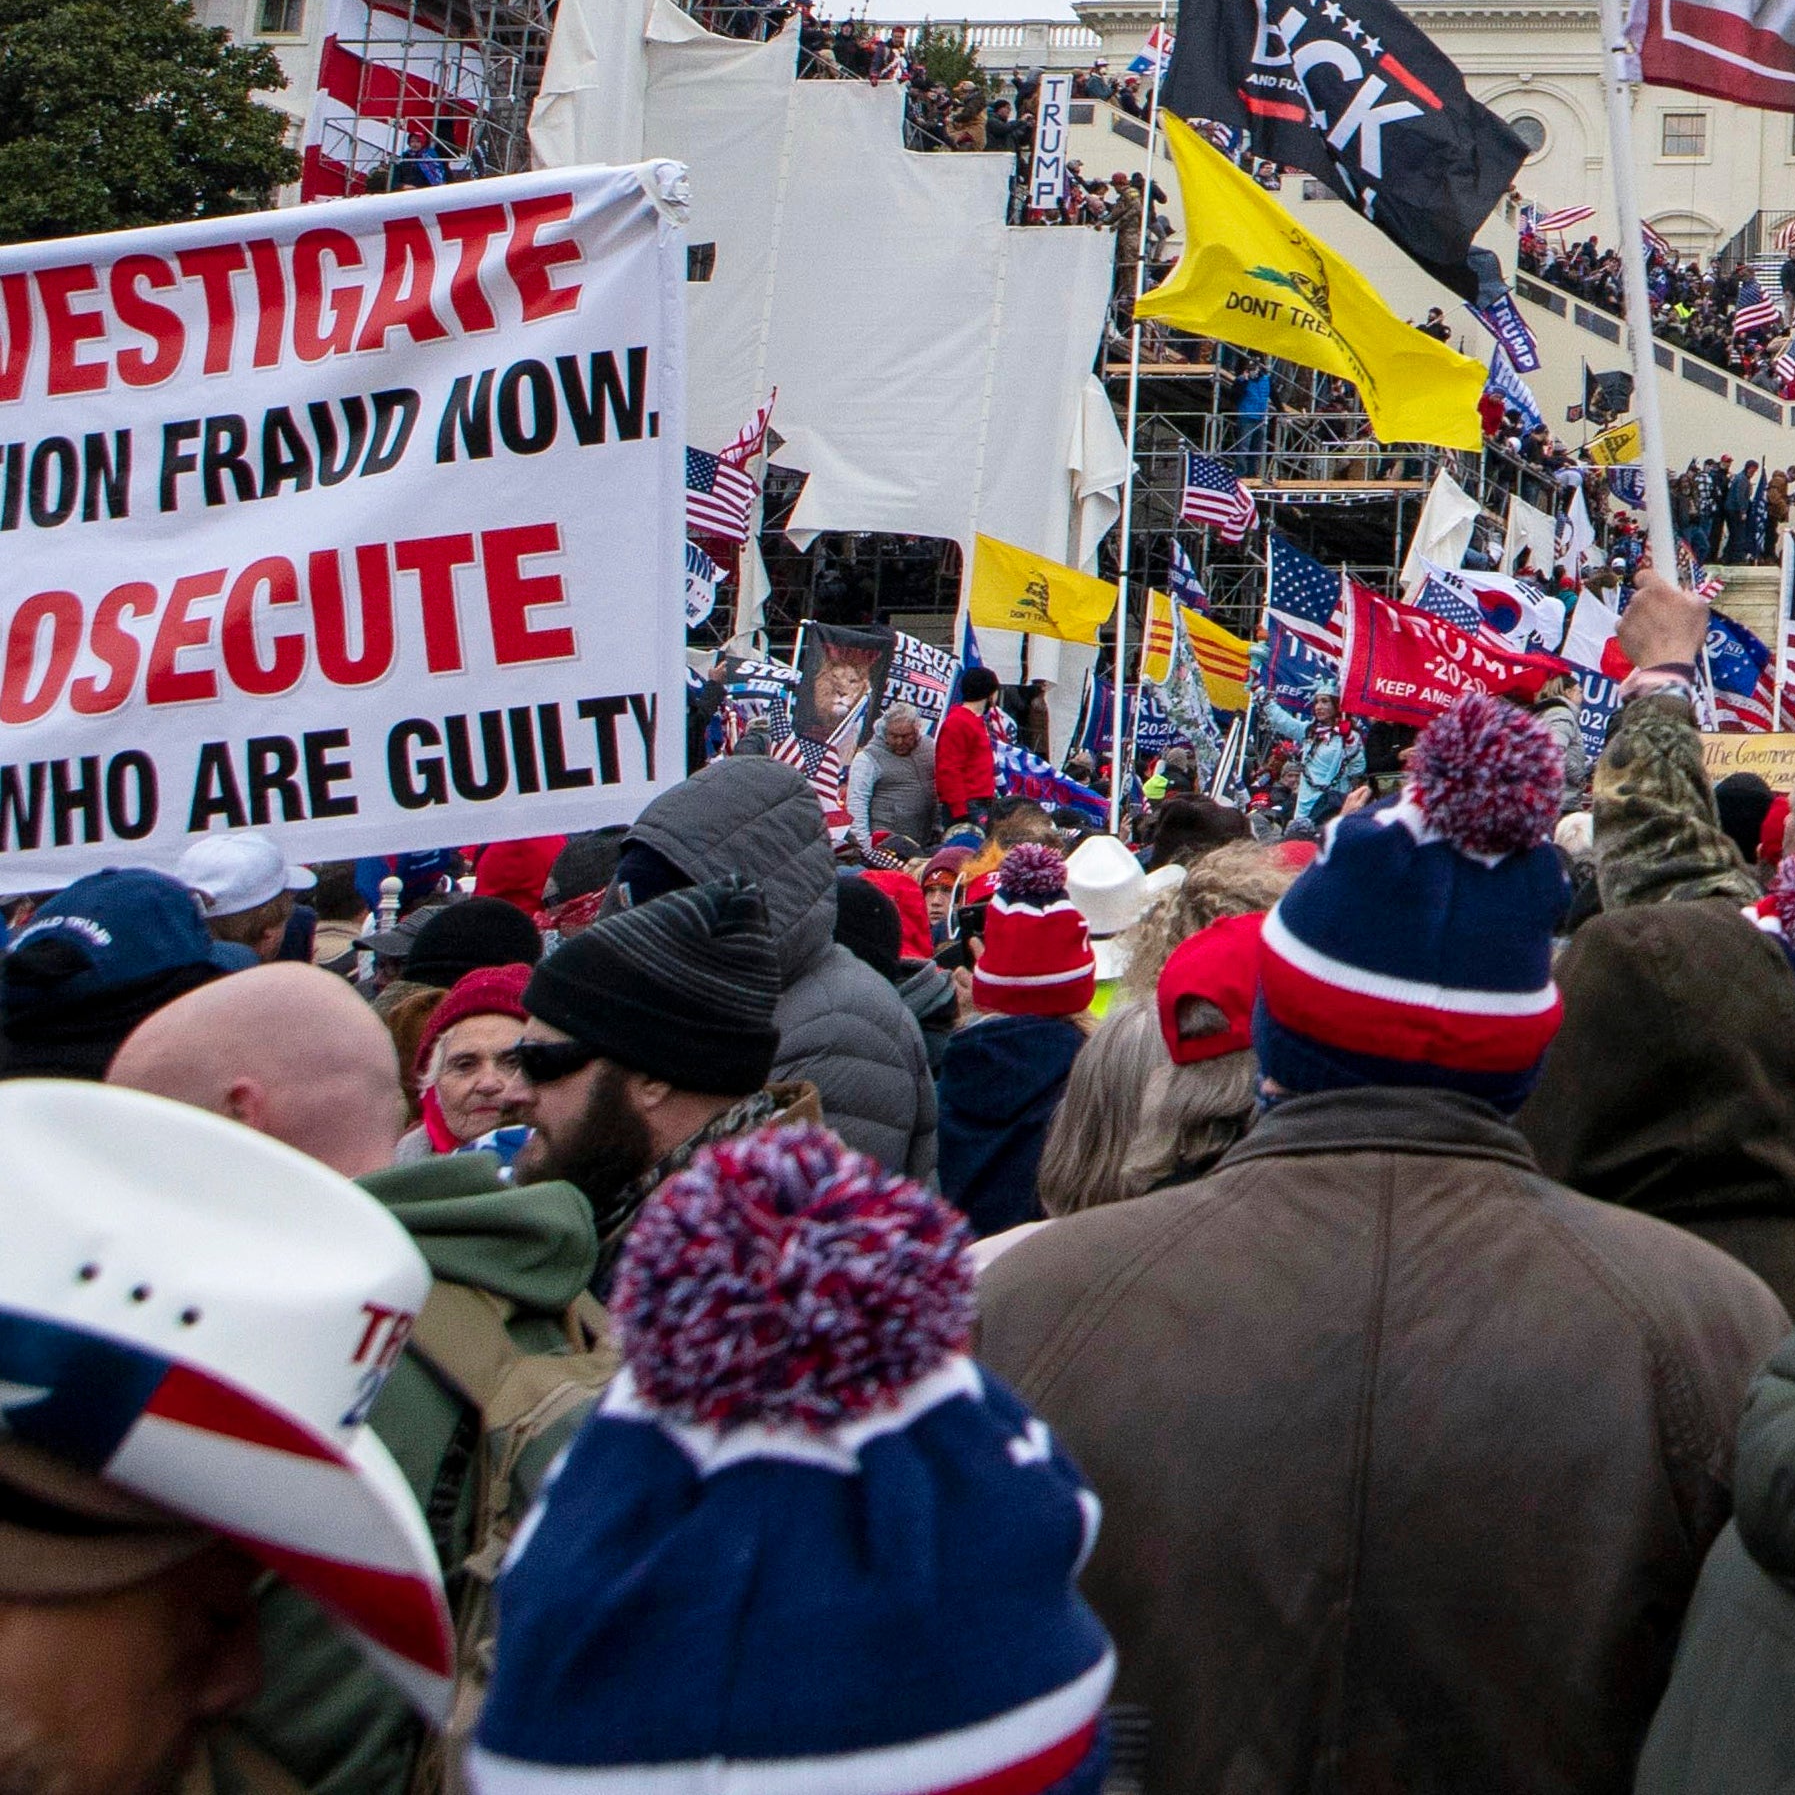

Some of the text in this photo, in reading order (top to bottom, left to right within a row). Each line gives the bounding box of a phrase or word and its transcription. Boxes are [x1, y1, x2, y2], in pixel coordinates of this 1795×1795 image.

[1246, 72, 1305, 94] AND FUC
[1035, 78, 1066, 206] TRUMP
[1226, 291, 1284, 322] DONT
[1492, 294, 1534, 369] TRUMP
[159, 388, 423, 514] FRAUD
[436, 346, 660, 466] NOW.
[892, 630, 963, 677] JESUS
[905, 657, 923, 673] MY
[1275, 684, 1304, 697] KEEP
[1375, 677, 1417, 700] KEEP
[1703, 741, 1733, 766] The
[0, 692, 659, 854] WHO ARE GUILTY
[63, 915, 113, 946] TRUMP
